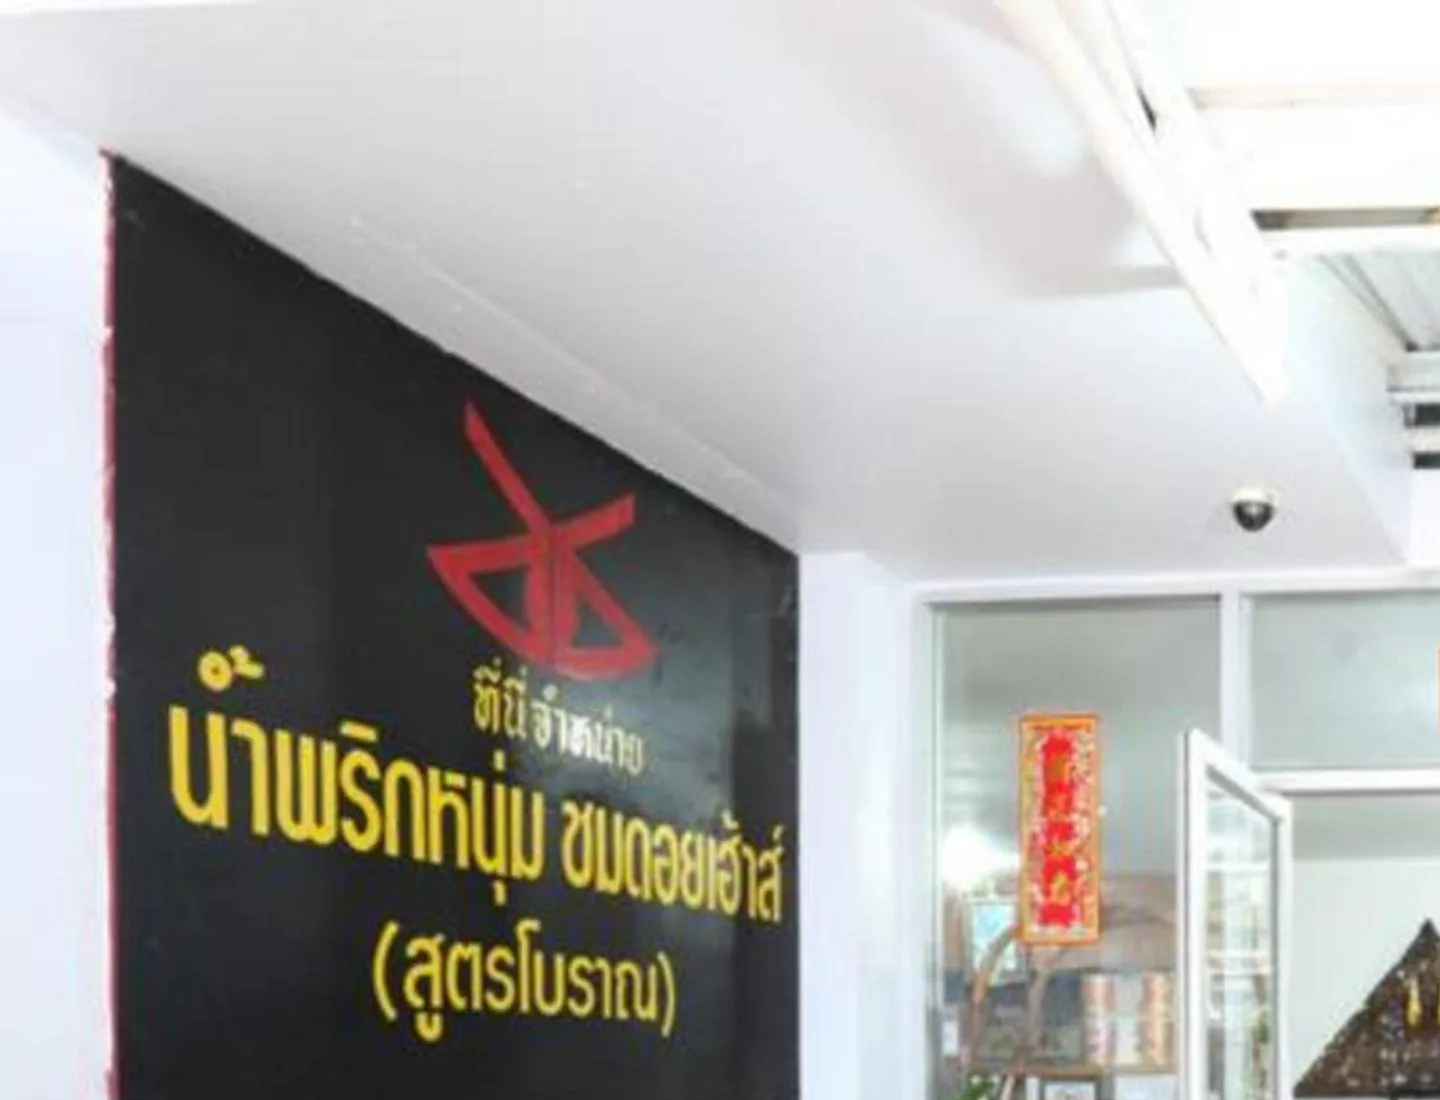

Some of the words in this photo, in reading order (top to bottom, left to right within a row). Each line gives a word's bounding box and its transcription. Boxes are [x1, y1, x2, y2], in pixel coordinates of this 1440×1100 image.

[168, 645, 546, 906] น้ำพริกหนุ่ม
[560, 810, 785, 922] ชมดอยเฮ้าส์
[372, 918, 677, 1042] (สูตรโบราณ)
